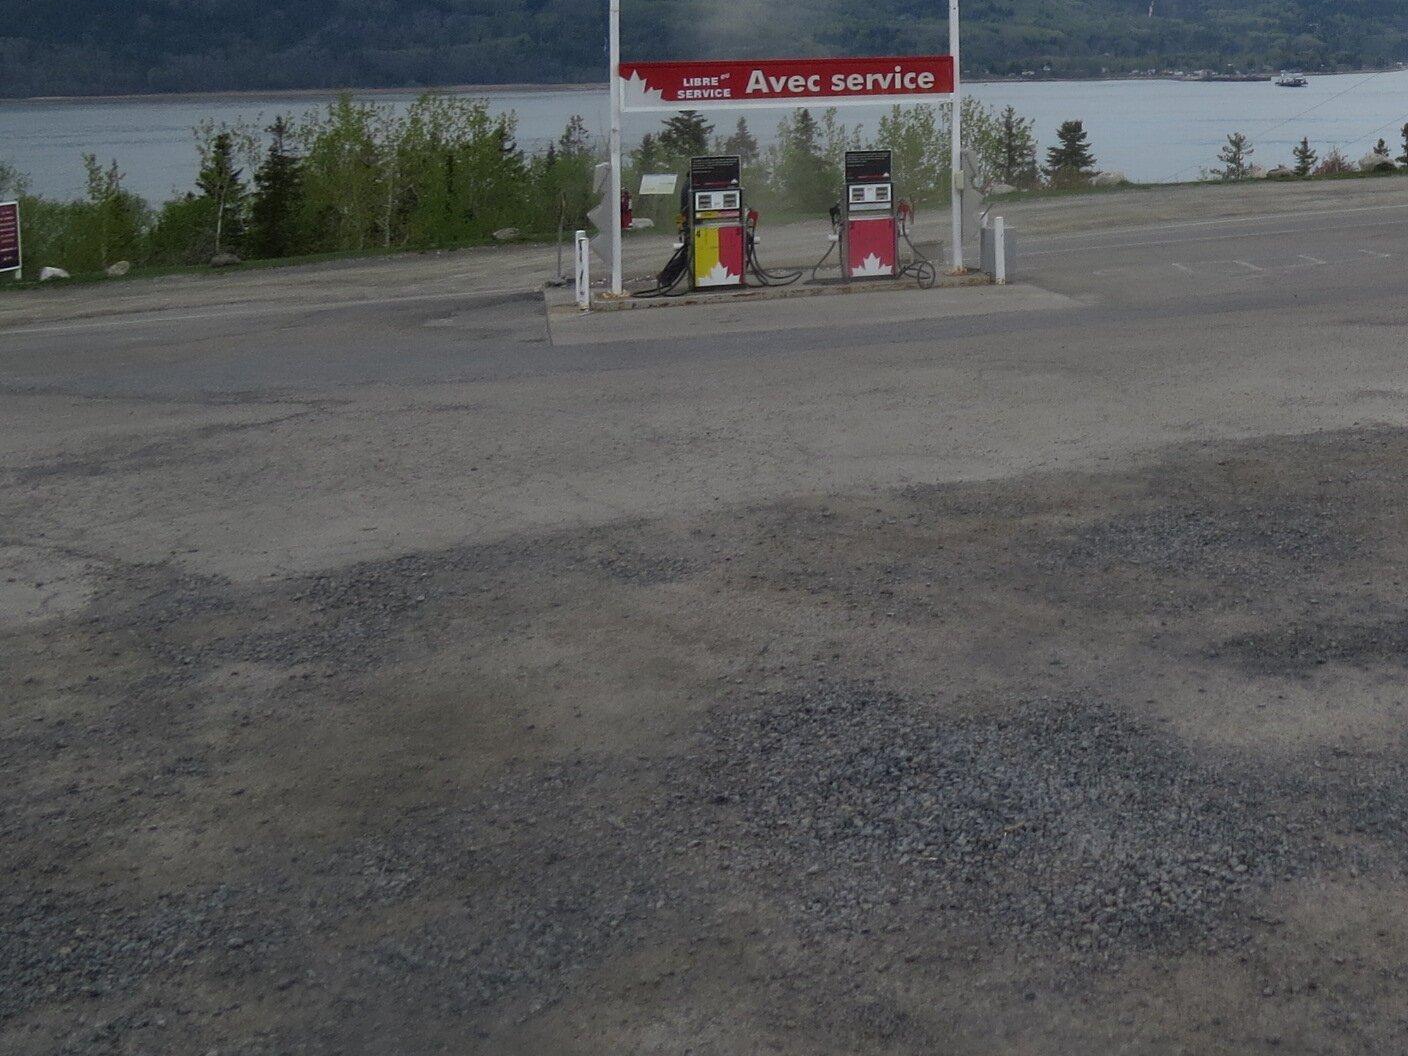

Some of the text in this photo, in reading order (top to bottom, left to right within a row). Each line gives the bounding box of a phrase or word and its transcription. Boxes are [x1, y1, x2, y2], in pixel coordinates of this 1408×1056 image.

[683, 77, 719, 87] LIBRE
[745, 65, 936, 94] Avec service
[677, 88, 732, 99] SERVICE
